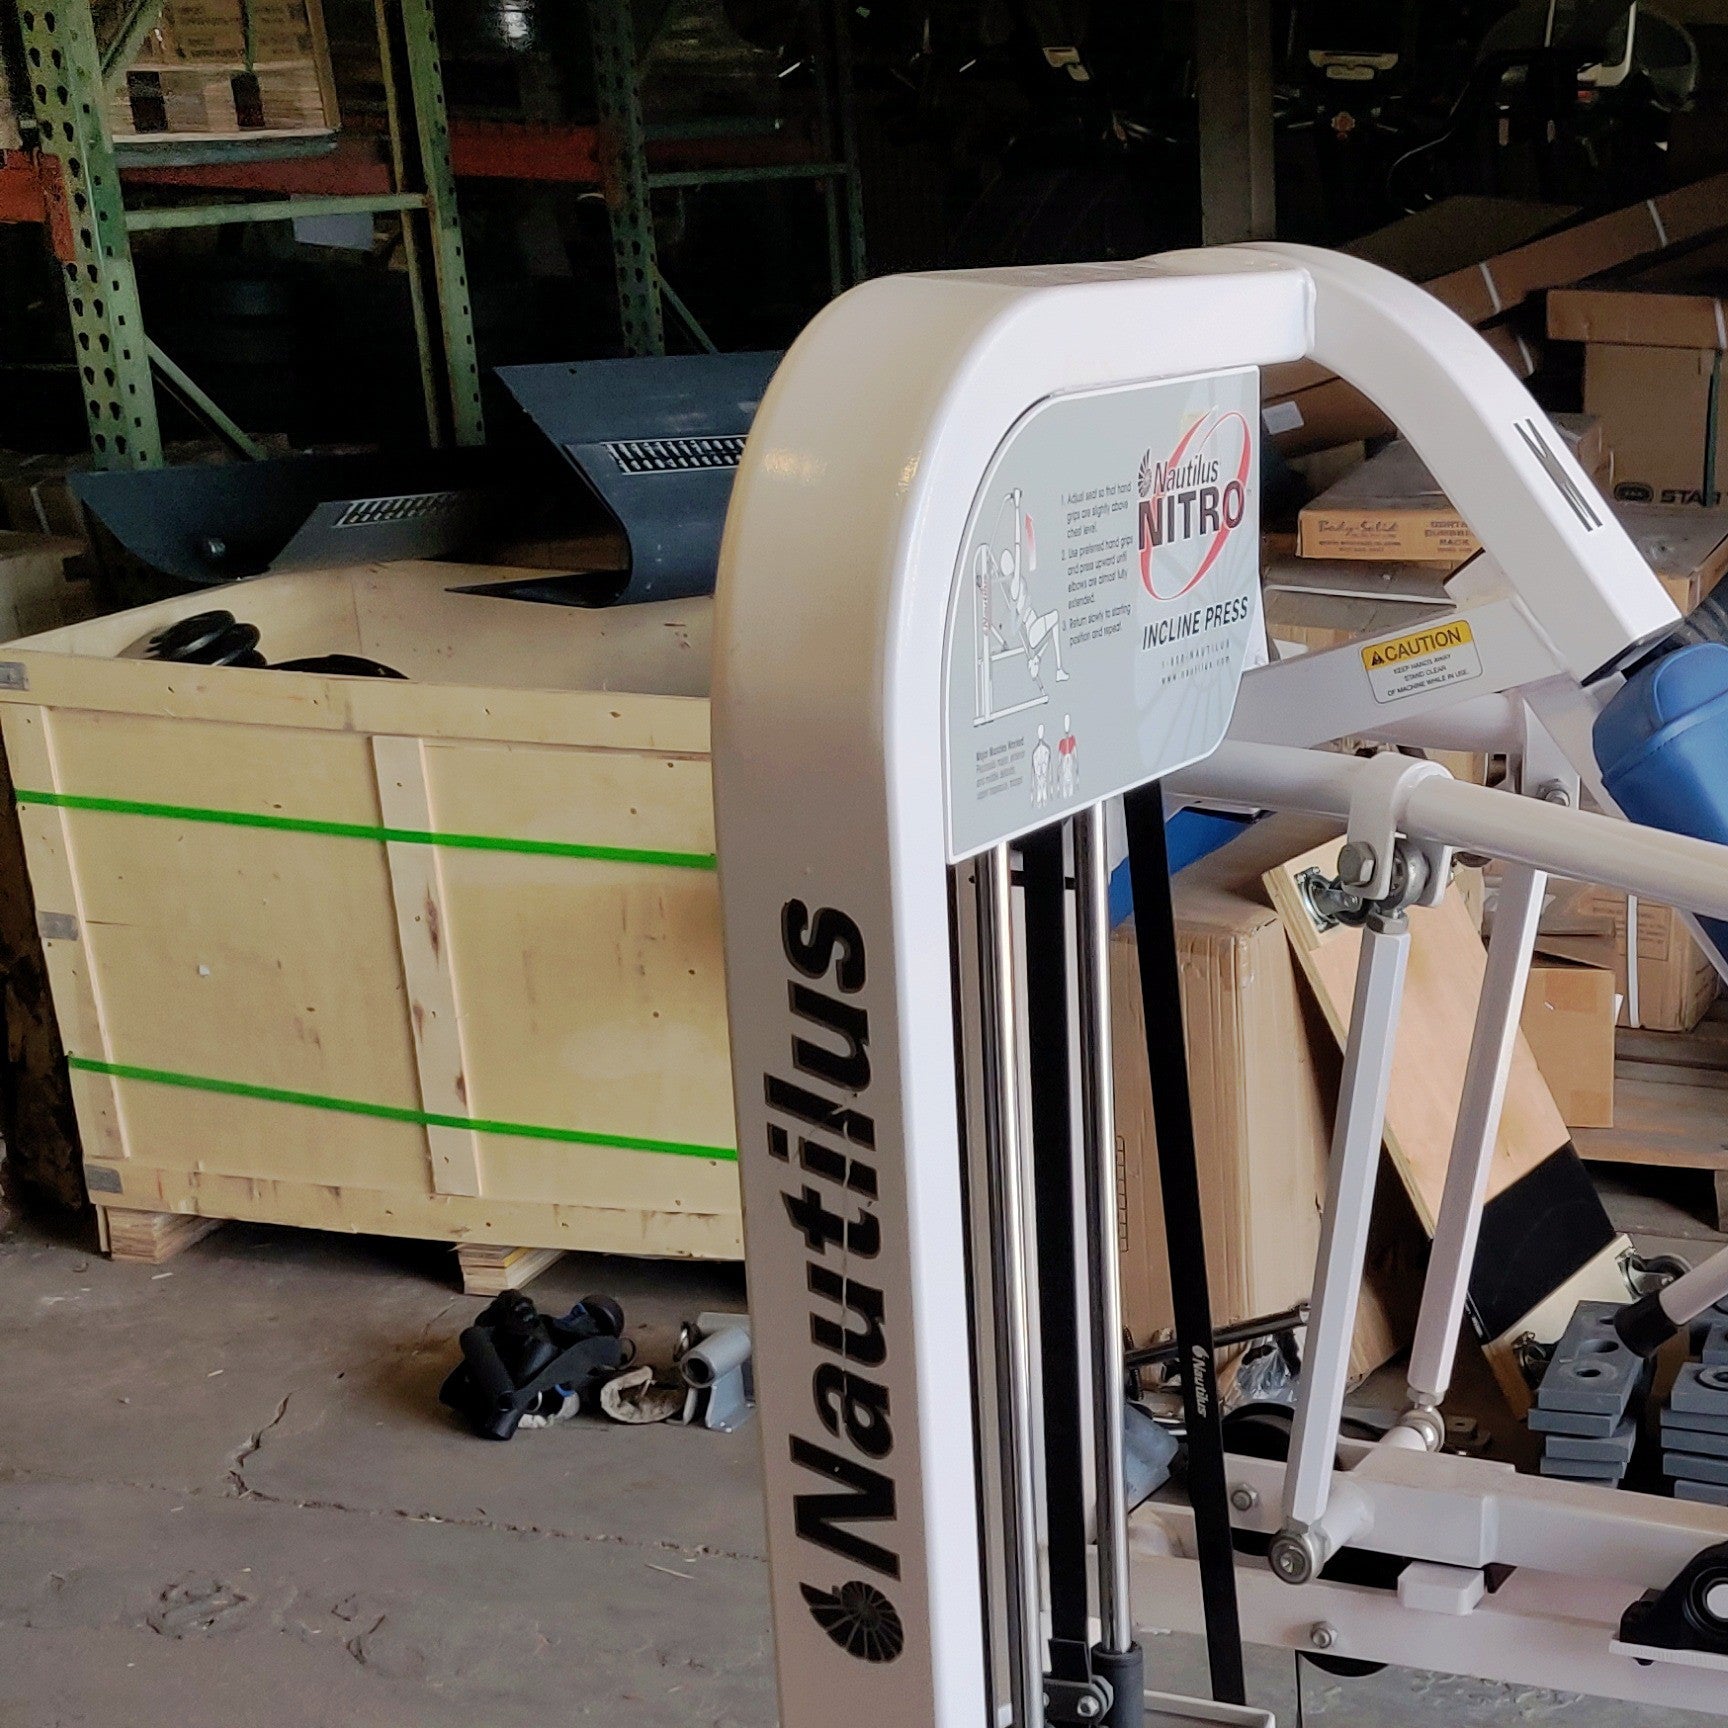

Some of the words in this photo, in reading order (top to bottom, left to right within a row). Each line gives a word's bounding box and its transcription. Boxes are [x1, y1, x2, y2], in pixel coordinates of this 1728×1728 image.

[1154, 454, 1219, 494] Nautilus
[1139, 480, 1244, 550] NITRO
[1143, 610, 1201, 650] INCLINE
[1205, 596, 1248, 631] PRESS
[1384, 627, 1462, 662] CAUTION
[1394, 665, 1410, 674] KEEP
[1411, 658, 1432, 670] HANDS
[1434, 654, 1451, 664] AWAY
[1387, 688, 1395, 696] OF
[1397, 681, 1426, 694] MACHINE
[1427, 676, 1446, 686] WHILE
[1404, 672, 1425, 682] STAND
[1426, 665, 1447, 676] CLEAR
[763, 898, 900, 1581] Nautilus
[1192, 1356, 1209, 1418] Nautilus
